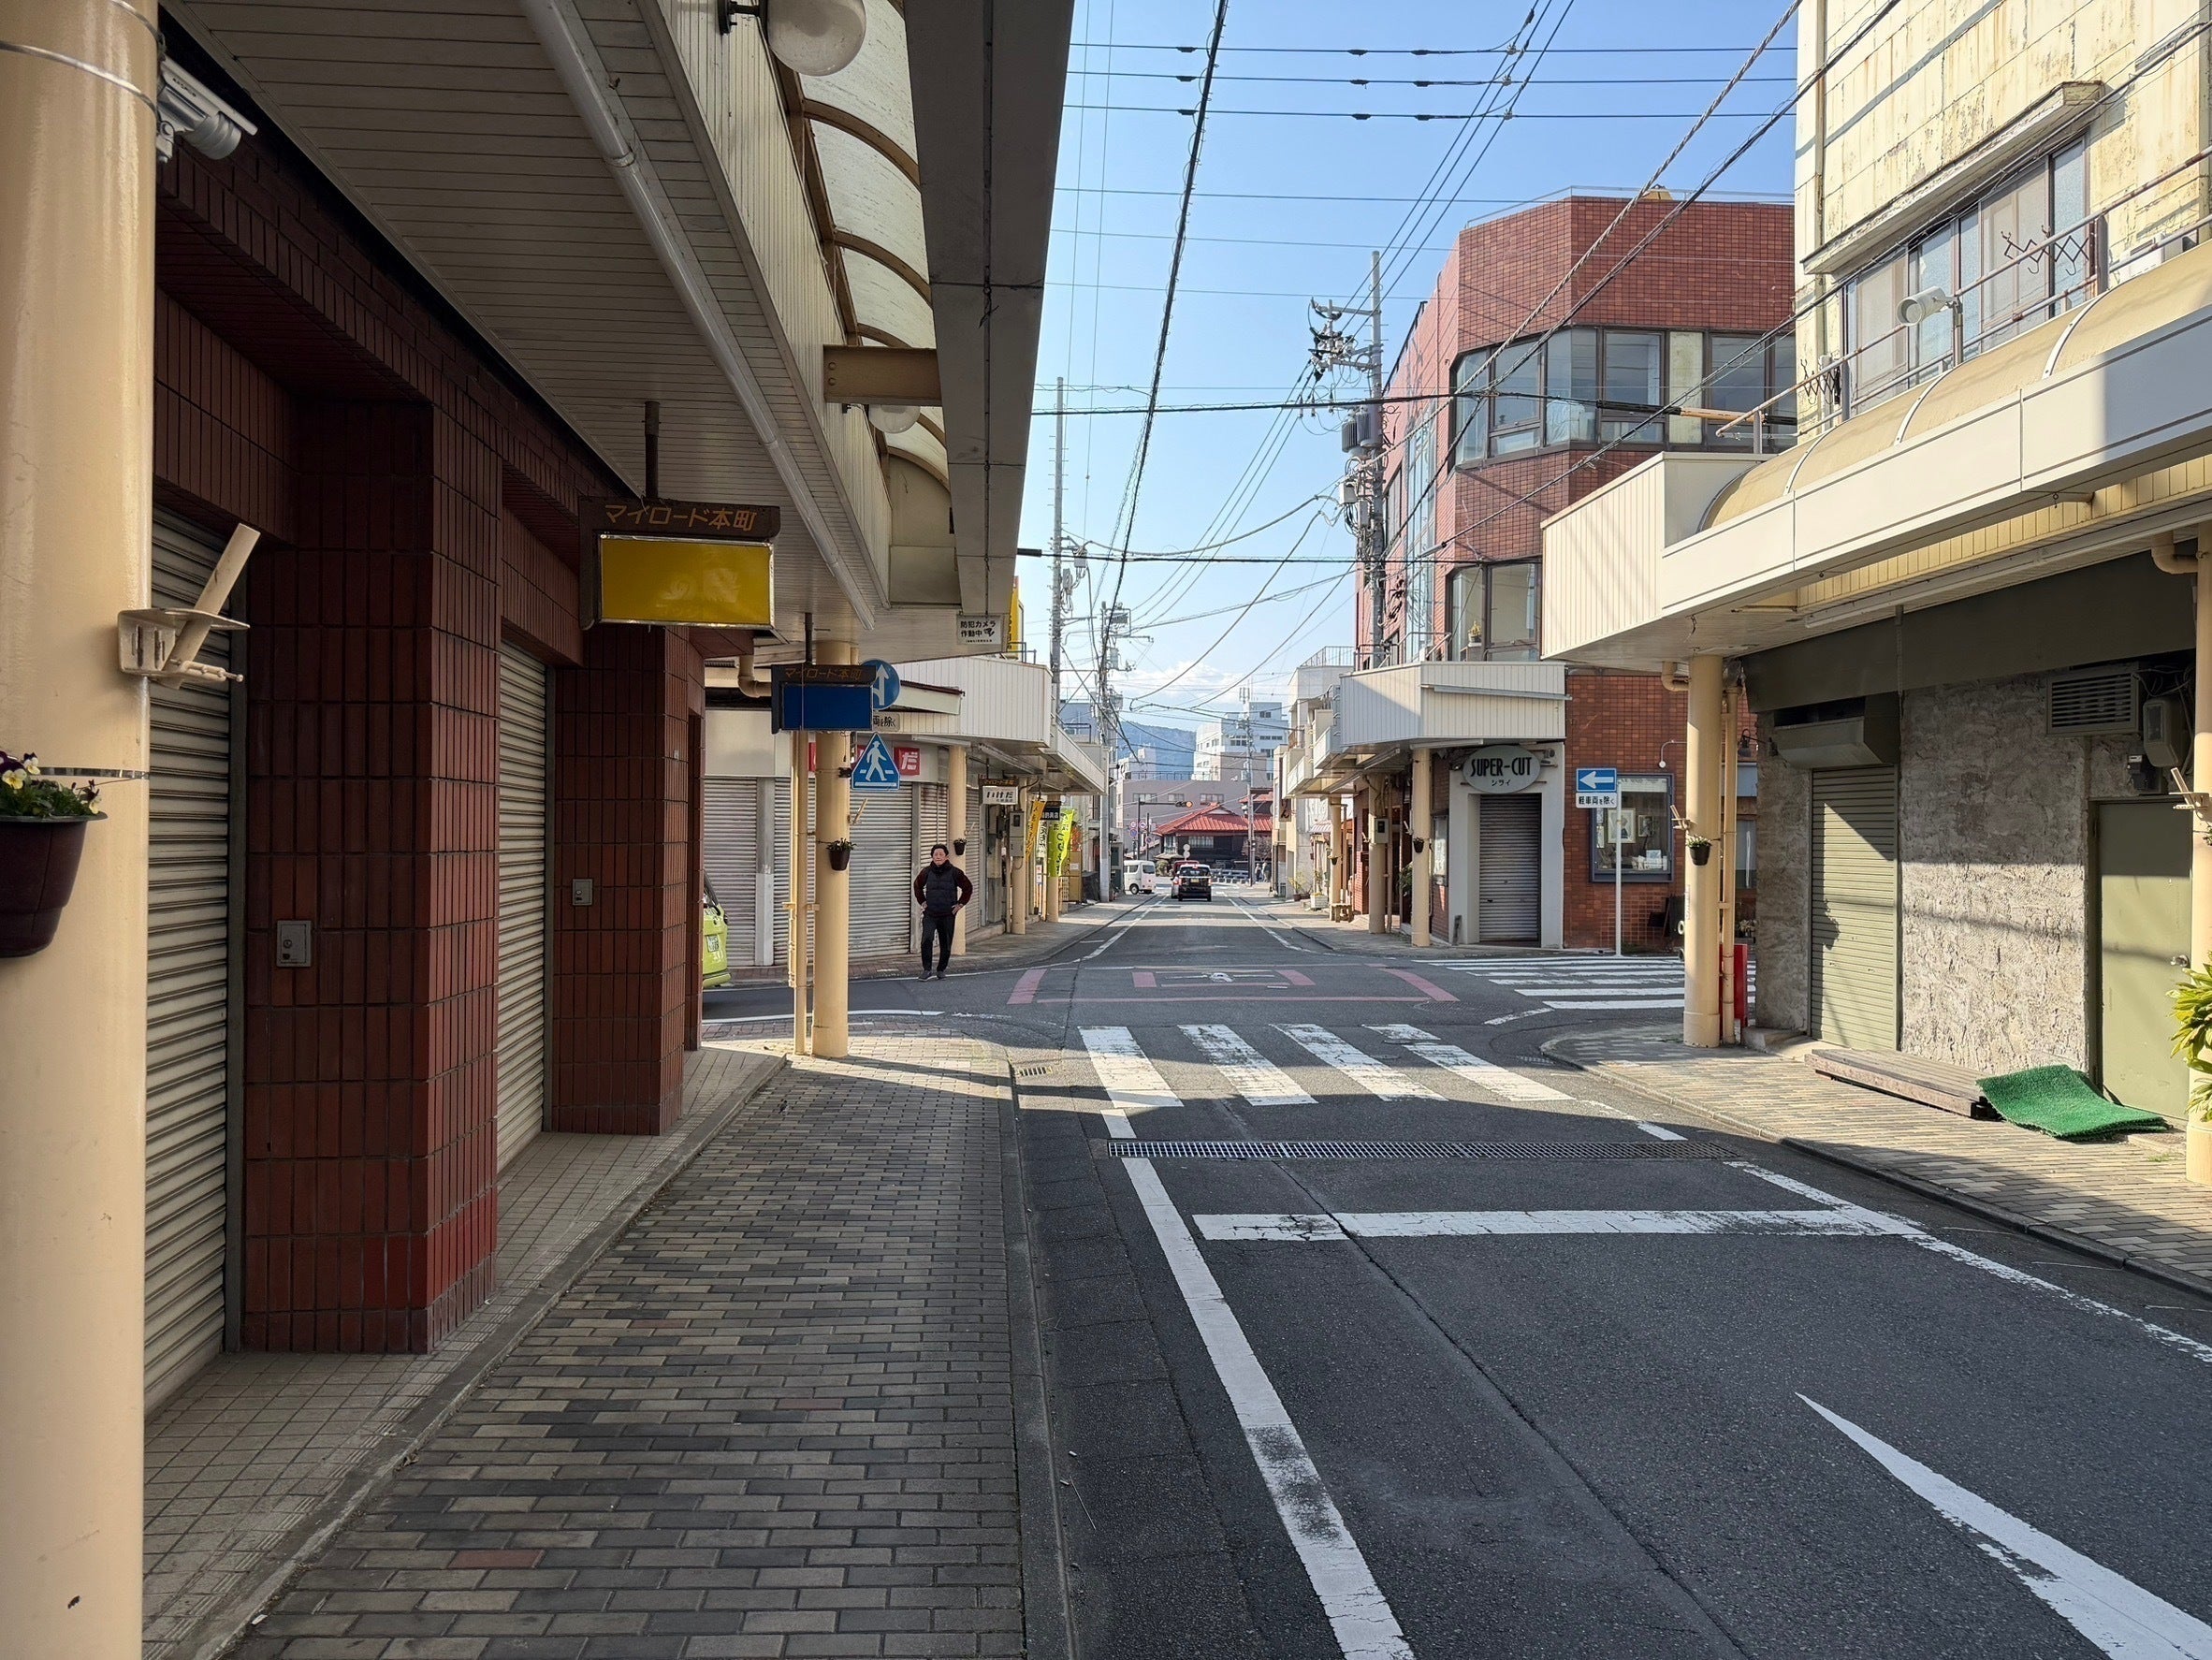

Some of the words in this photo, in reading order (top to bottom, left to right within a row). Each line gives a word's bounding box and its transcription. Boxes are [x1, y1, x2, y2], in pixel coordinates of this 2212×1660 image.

[604, 504, 757, 531] マイロード本町
[872, 715, 896, 727] 両を除く
[1470, 757, 1533, 777] SUPER-CUT
[1579, 795, 1615, 805] 軽車両を除く
